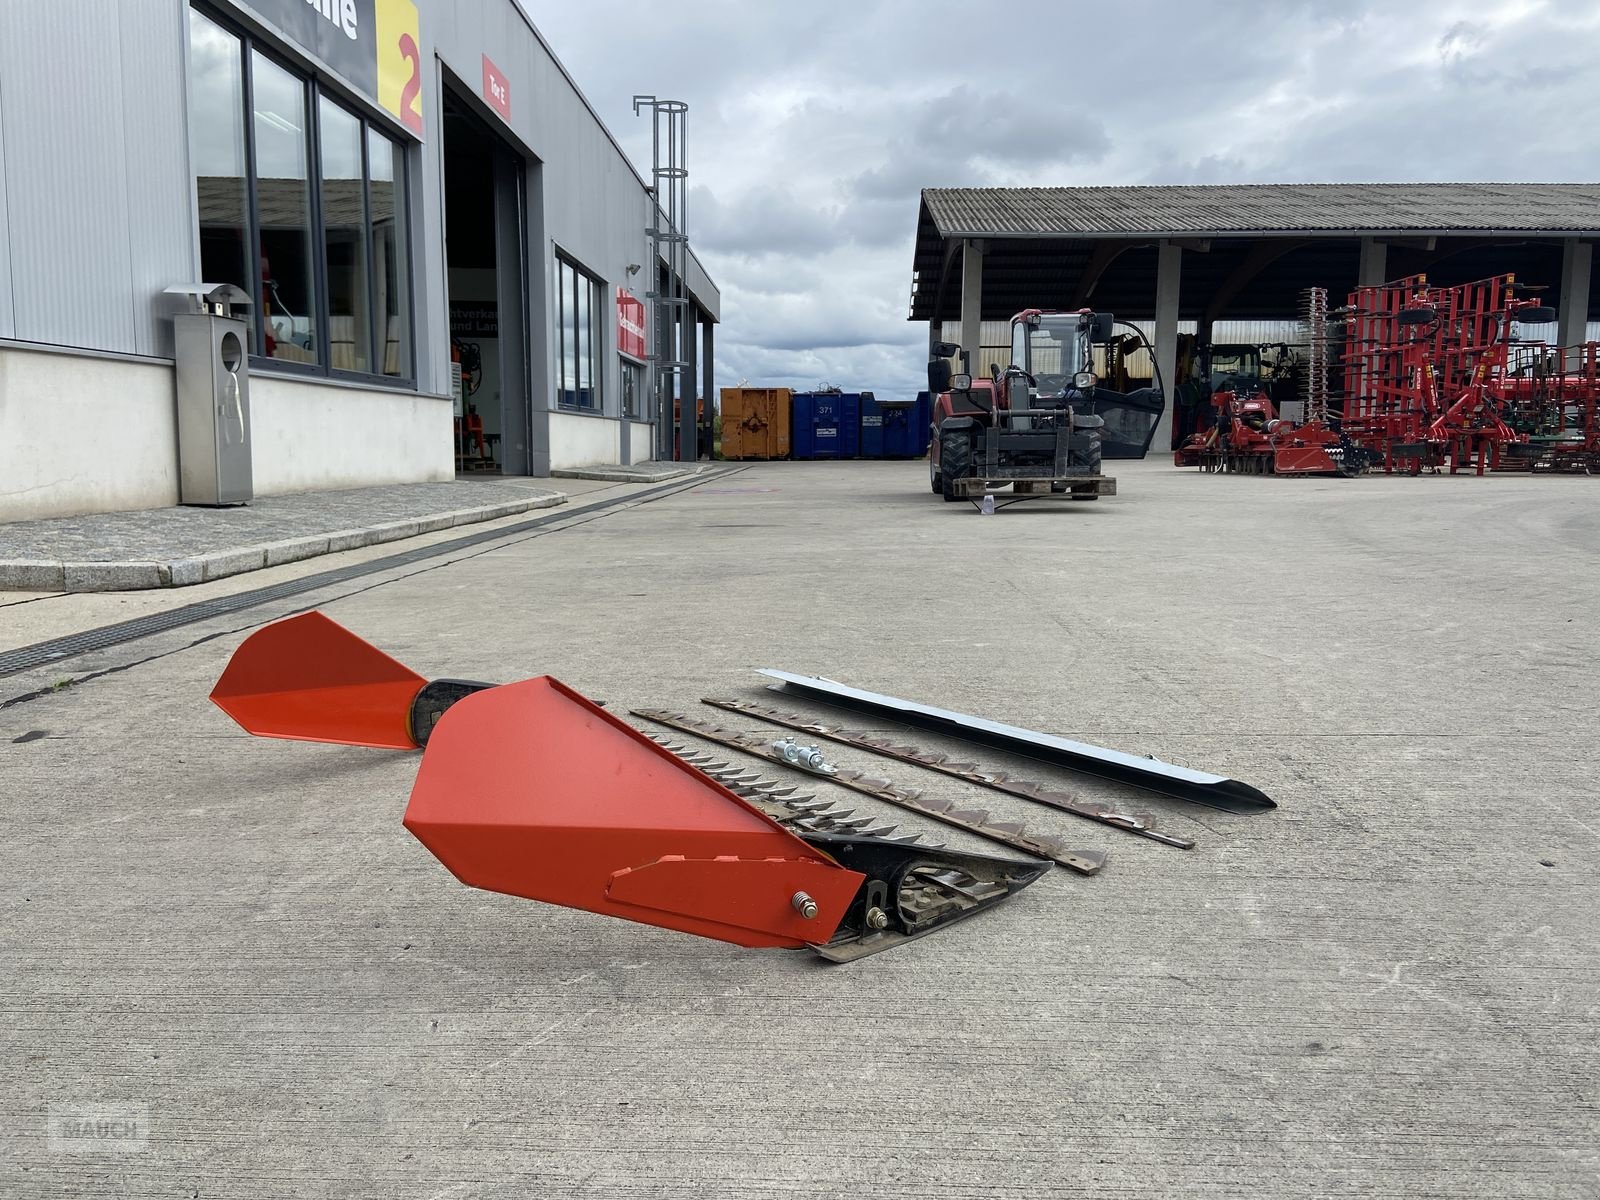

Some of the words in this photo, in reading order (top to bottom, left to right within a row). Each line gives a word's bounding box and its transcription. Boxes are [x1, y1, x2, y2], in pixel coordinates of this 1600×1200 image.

[305, 0, 358, 40] lle
[399, 33, 422, 134] 2
[500, 86, 506, 106] E
[818, 406, 833, 414] 371
